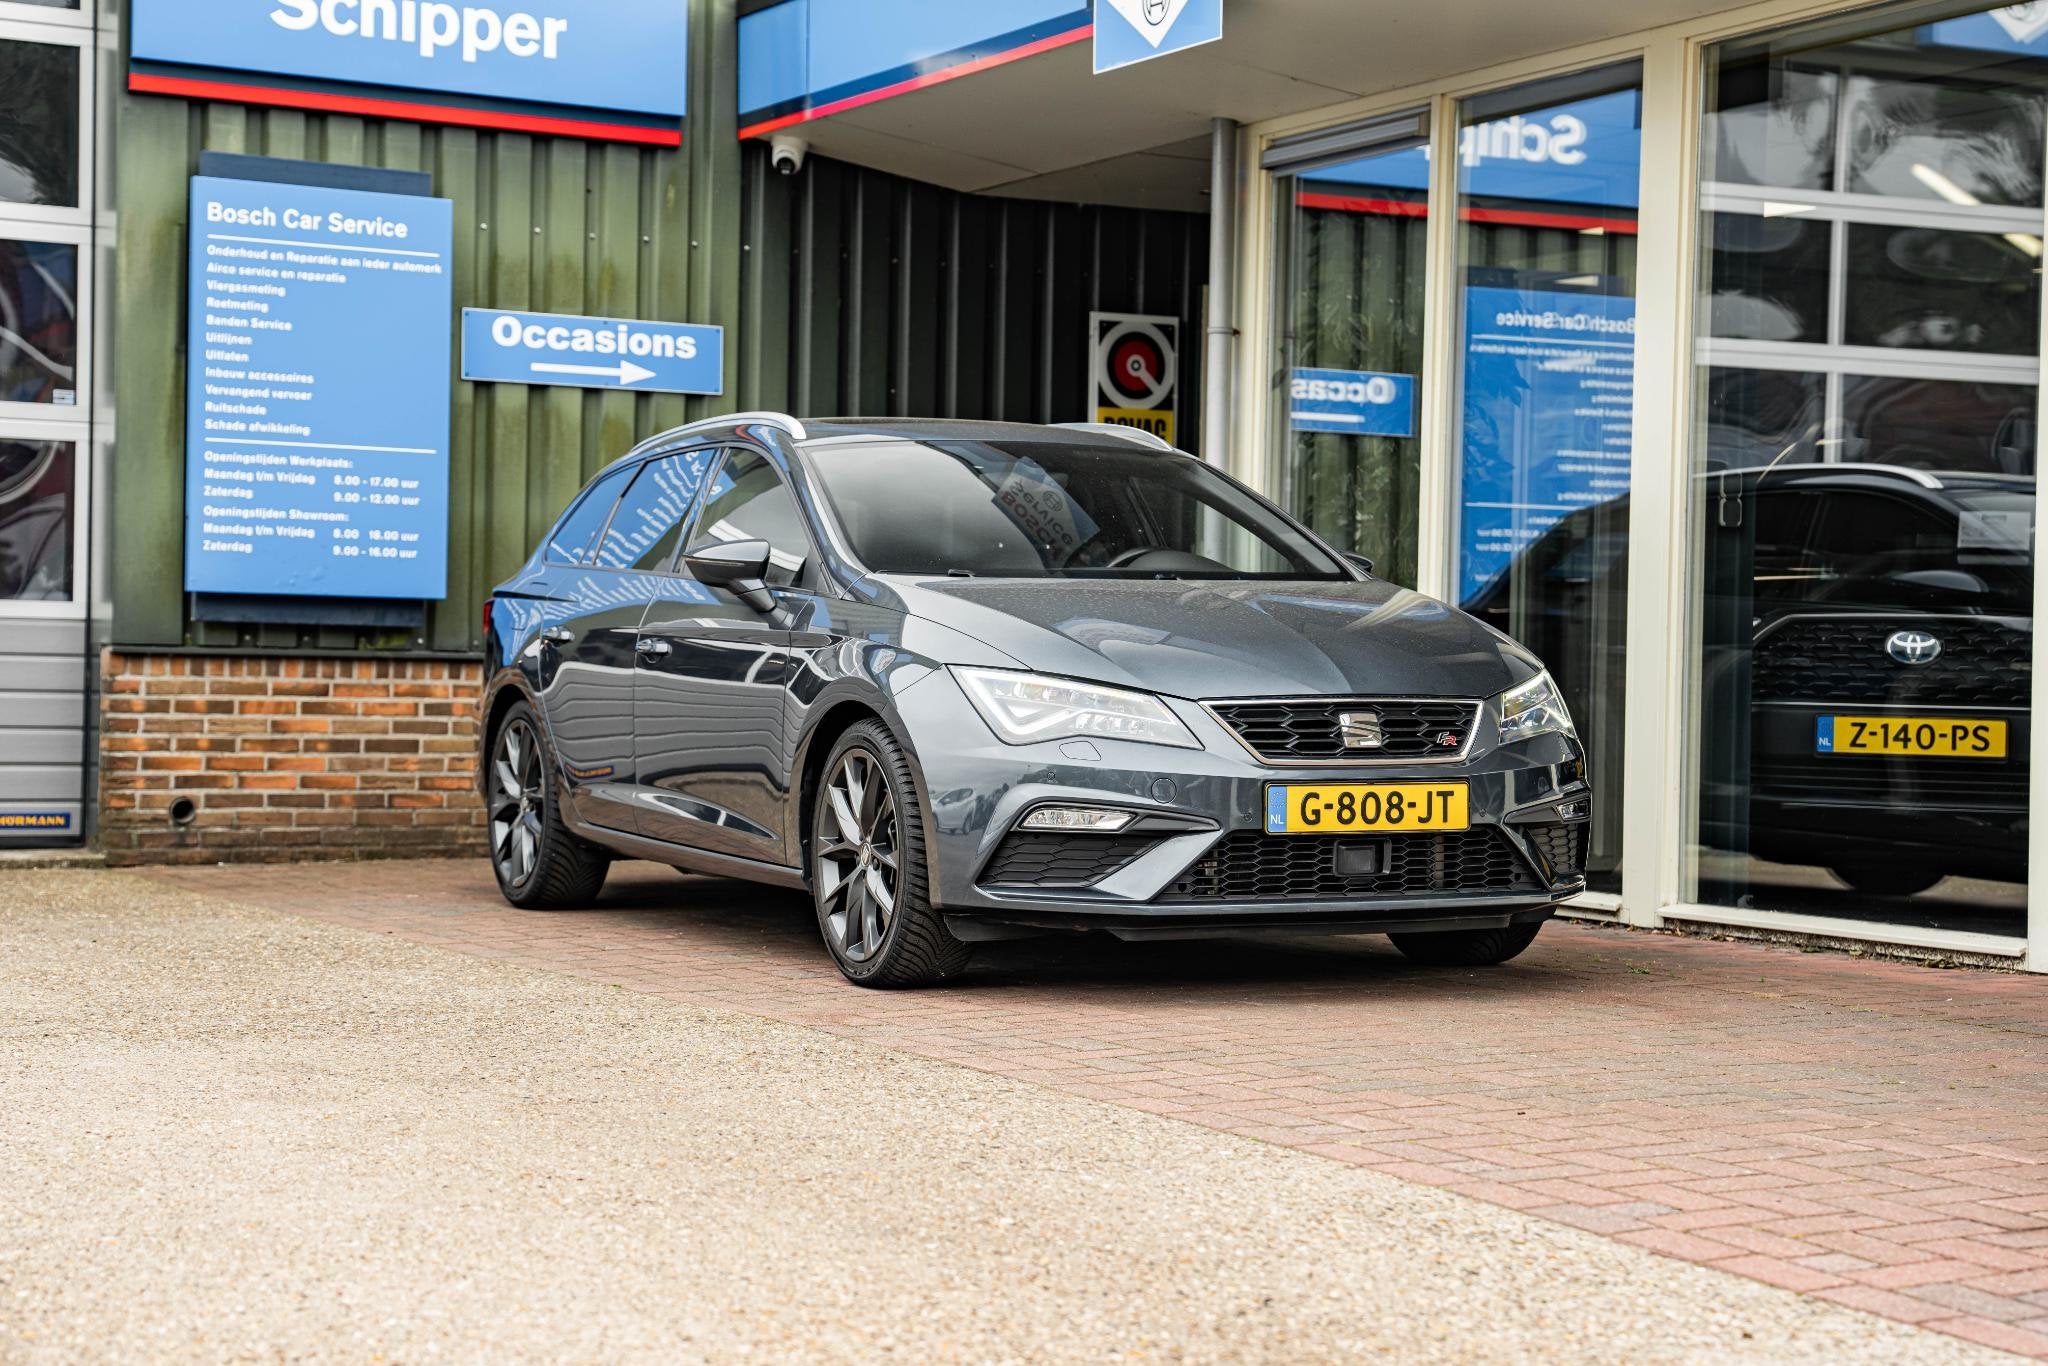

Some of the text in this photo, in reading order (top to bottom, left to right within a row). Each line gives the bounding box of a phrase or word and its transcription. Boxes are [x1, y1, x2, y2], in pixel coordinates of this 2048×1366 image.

[207, 202, 408, 239] Bosch Car Service
[207, 245, 268, 260] Onderhoud
[270, 252, 284, 261] en
[287, 252, 338, 266] Reparatie
[207, 263, 346, 284] Airco service en reparatie
[207, 280, 285, 299] Viergasmeting
[206, 315, 292, 331] Banden Service
[206, 332, 252, 345] Uitlijnen
[492, 314, 696, 359] Occasions
[206, 368, 314, 384] Inbouw accessoires
[206, 384, 311, 401] Vervangend vervoer
[205, 401, 266, 415] Ruitschade
[205, 419, 310, 437] Schade afwikkeling
[204, 451, 287, 466] Openingstijden
[204, 468, 254, 482] Maandag
[256, 471, 274, 482] t/m
[277, 472, 315, 486] Vrijdag
[401, 481, 418, 489] uur
[204, 485, 253, 500] Zaterdag
[402, 498, 419, 506] uur
[203, 505, 286, 519] Openingstijden
[203, 523, 253, 537] Maandag
[256, 526, 273, 536] t/m
[277, 527, 315, 539] Vrijdag
[401, 534, 418, 542] uur
[203, 540, 252, 554] Zaterdag
[400, 551, 416, 559] uur
[1437, 732, 1457, 745] FR
[1818, 722, 1990, 751] NL Z-140-PS
[1270, 790, 1454, 825] NL G-808-JT
